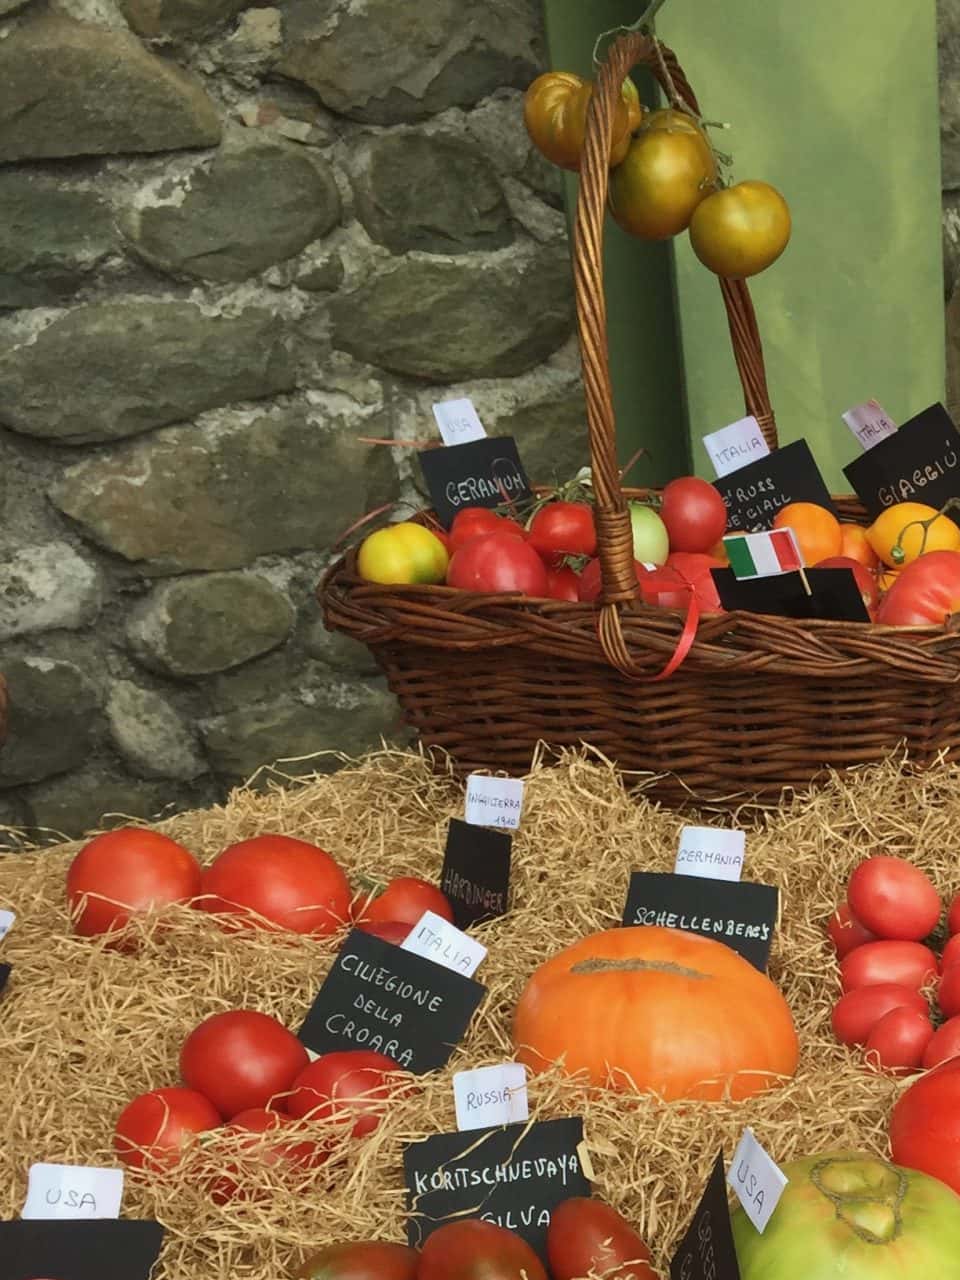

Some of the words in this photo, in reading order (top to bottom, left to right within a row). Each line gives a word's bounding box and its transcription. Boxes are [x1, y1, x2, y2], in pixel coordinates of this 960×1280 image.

[857, 419, 890, 441] ITALIA
[715, 438, 762, 464] ITALIA
[446, 473, 525, 506] GERANIUM
[736, 478, 775, 502] RUSS
[677, 850, 741, 865] GERMANIA
[417, 927, 472, 971] ITALIA
[340, 954, 443, 1012] CILIEGIONE
[353, 993, 402, 1027] DELLA
[325, 1014, 413, 1067] CROARA
[467, 1087, 512, 1111] RUSSIA
[45, 1189, 97, 1211] USA
[737, 1159, 765, 1214] USA
